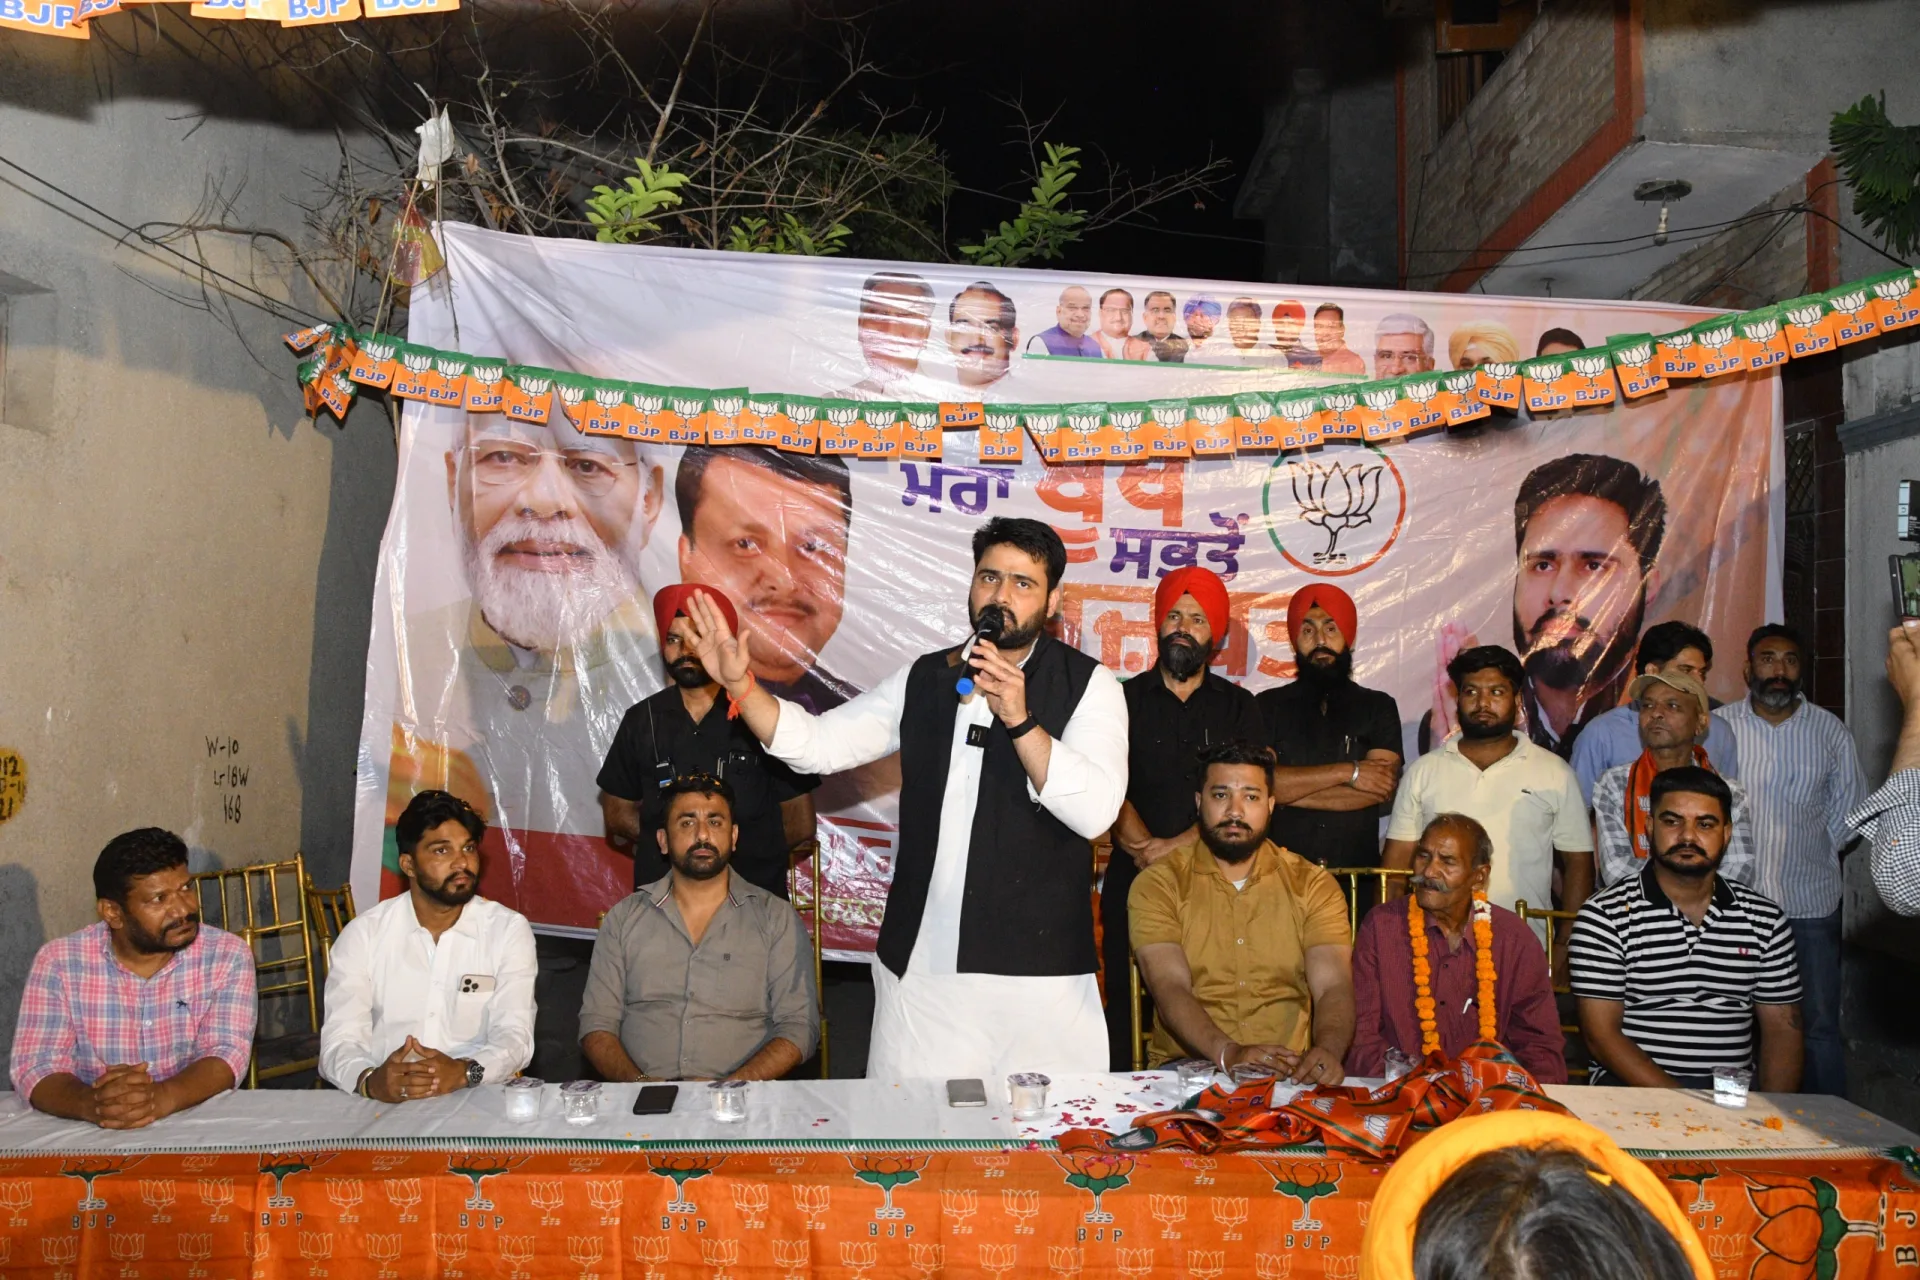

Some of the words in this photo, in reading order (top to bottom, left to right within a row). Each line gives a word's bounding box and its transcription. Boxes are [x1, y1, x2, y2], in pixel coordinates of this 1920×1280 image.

[1883, 309, 1919, 327] BJP
[1840, 322, 1875, 339] BJP
[288, 333, 306, 348] BJ
[1794, 337, 1829, 353] BJP
[1704, 357, 1740, 374] BJP
[1751, 351, 1785, 368] BJP
[1664, 362, 1696, 372] BJP
[354, 367, 387, 381] BJP
[397, 383, 426, 395] BJP
[1628, 375, 1661, 393] BJP
[321, 388, 343, 412] BJP
[429, 389, 458, 400] BJP
[1479, 388, 1515, 401] BJP
[1575, 389, 1610, 400] BJP
[471, 396, 503, 406] BJP
[1531, 395, 1566, 407] BJP
[511, 405, 544, 419] BJP
[1450, 402, 1484, 419] BJP
[945, 412, 979, 423] BJP
[1410, 412, 1442, 428] BJP
[589, 419, 621, 430] BJP
[1322, 424, 1357, 434] BJP
[1368, 420, 1404, 436] BJP
[628, 425, 660, 438] BJP
[669, 431, 700, 441] BJP
[743, 428, 776, 440] BJP
[781, 435, 812, 447] BJP
[825, 439, 859, 449] BJP
[1153, 440, 1187, 450] BJP
[1195, 438, 1230, 449] BJP
[1241, 435, 1274, 446] BJP
[1284, 432, 1318, 447] BJP
[863, 442, 895, 452] BJP
[904, 441, 937, 453] BJP
[984, 445, 1018, 456] BJP
[1068, 446, 1102, 457] BJP
[1110, 444, 1144, 455] BJP
[205, 735, 239, 758] W-10
